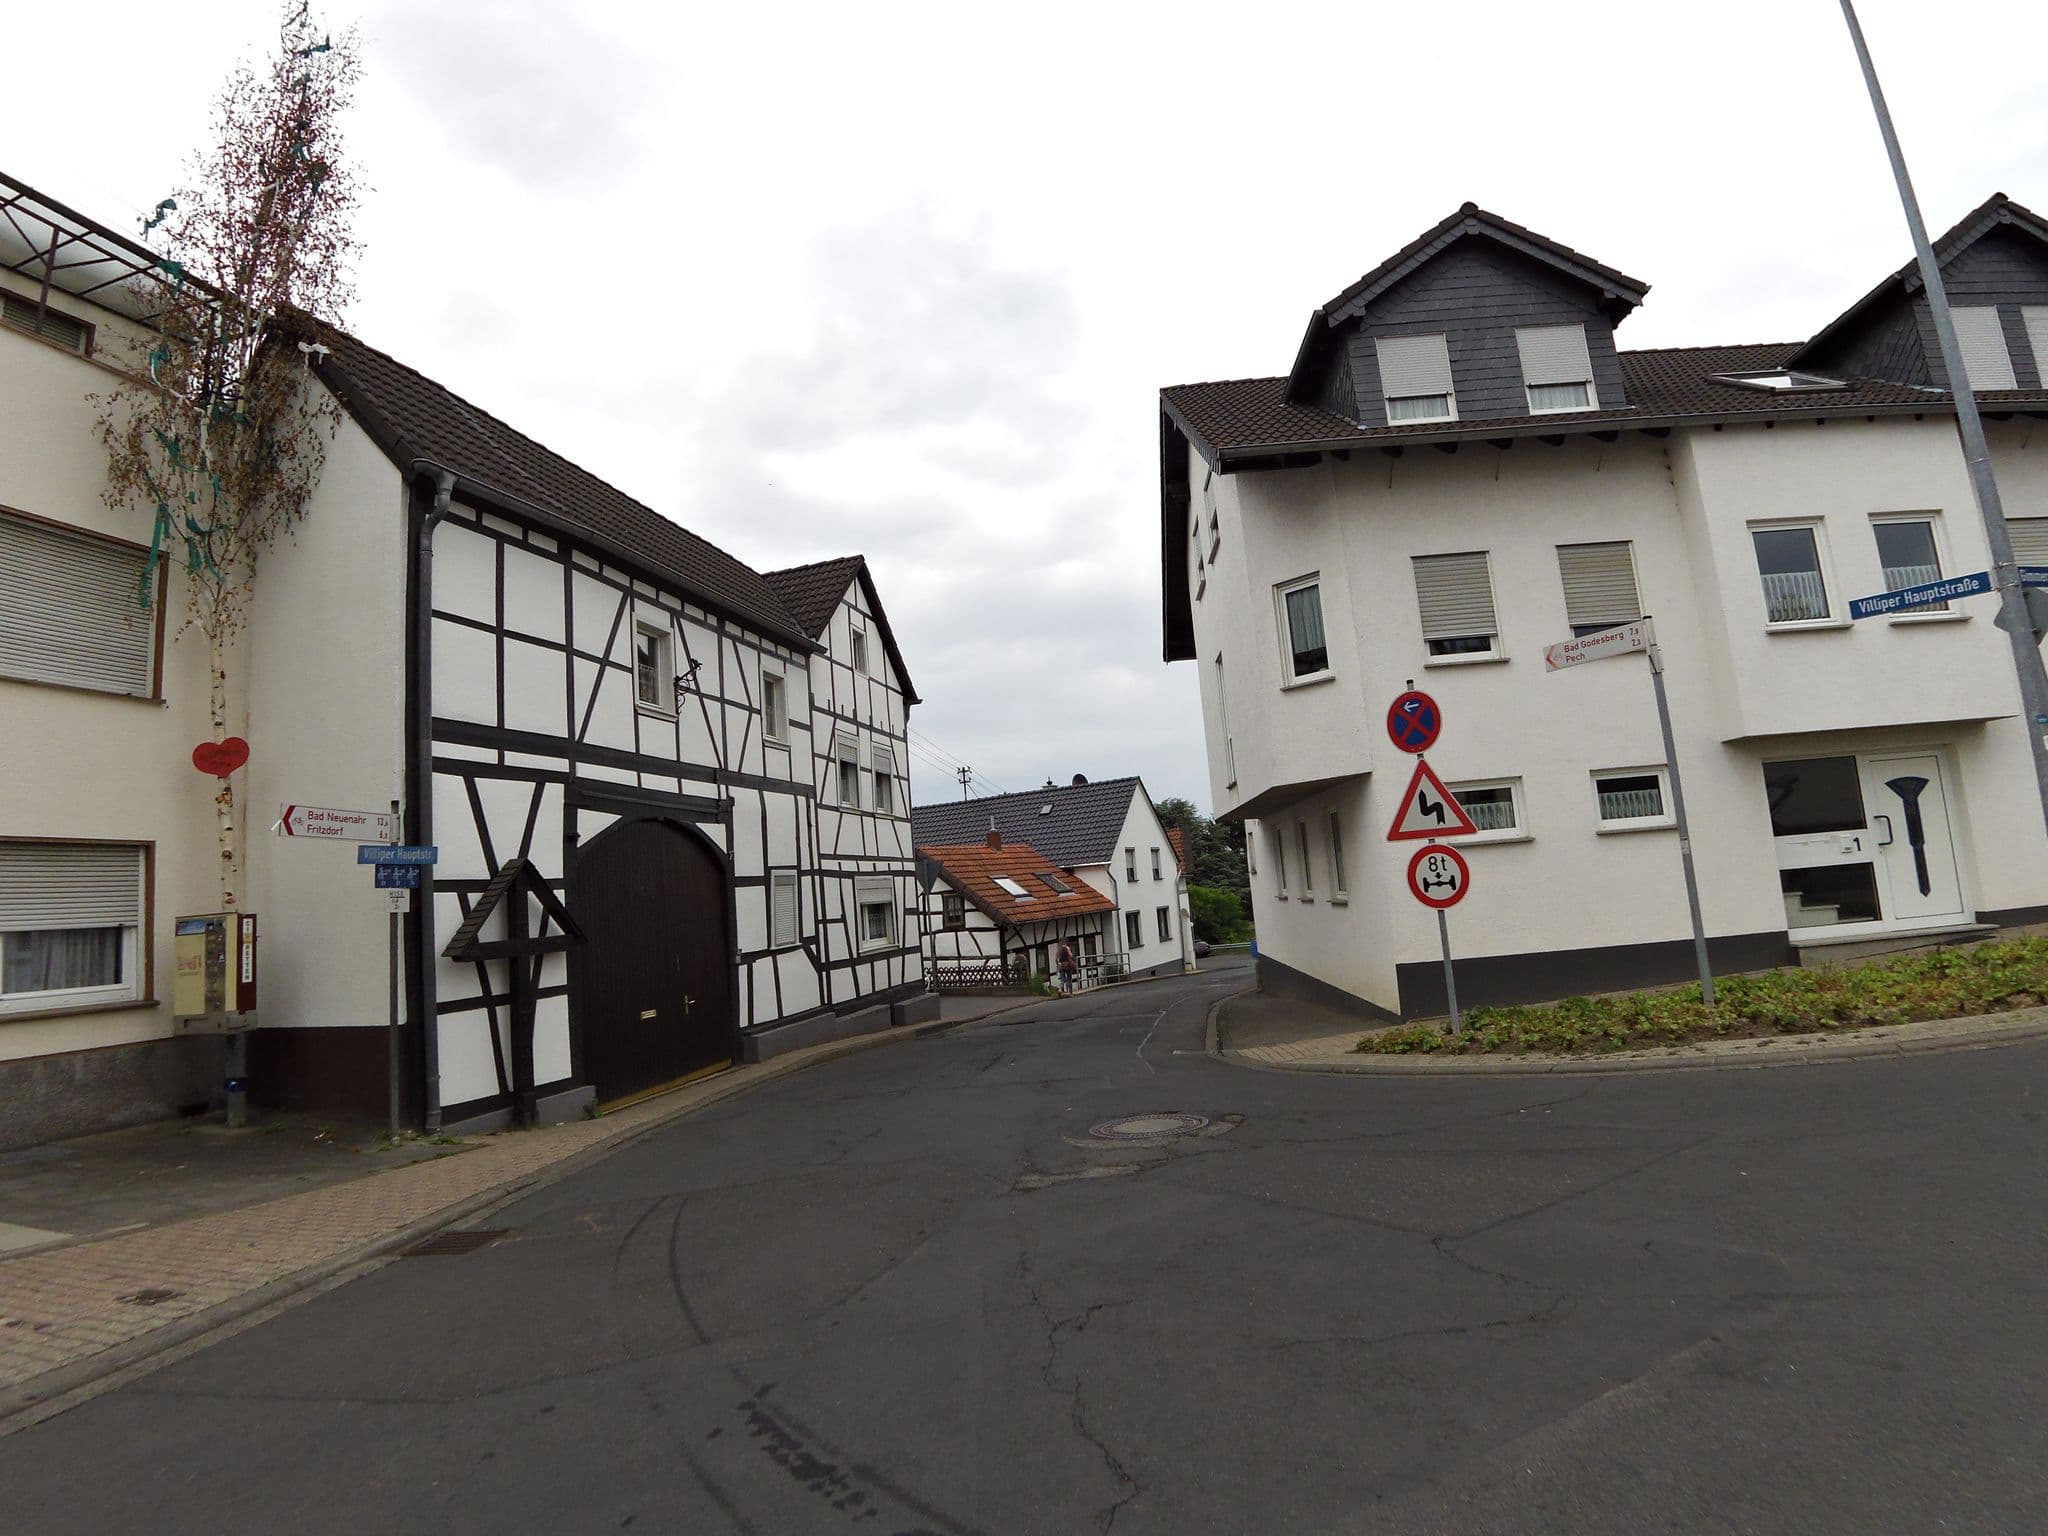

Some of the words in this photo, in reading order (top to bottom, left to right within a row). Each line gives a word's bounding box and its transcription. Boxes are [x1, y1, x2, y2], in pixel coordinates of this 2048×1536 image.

[1858, 595, 1901, 614] Villiper
[1903, 578, 1980, 605] Hauptstraße
[1563, 642, 1579, 653] Bad
[1580, 631, 1625, 649] Godesberg
[1565, 652, 1586, 663] Pech
[307, 811, 325, 821] Bad
[327, 812, 368, 825] Neuenahr
[306, 824, 344, 836] Fritzdorf
[1853, 837, 1862, 852] 1
[364, 848, 395, 861] Villiper
